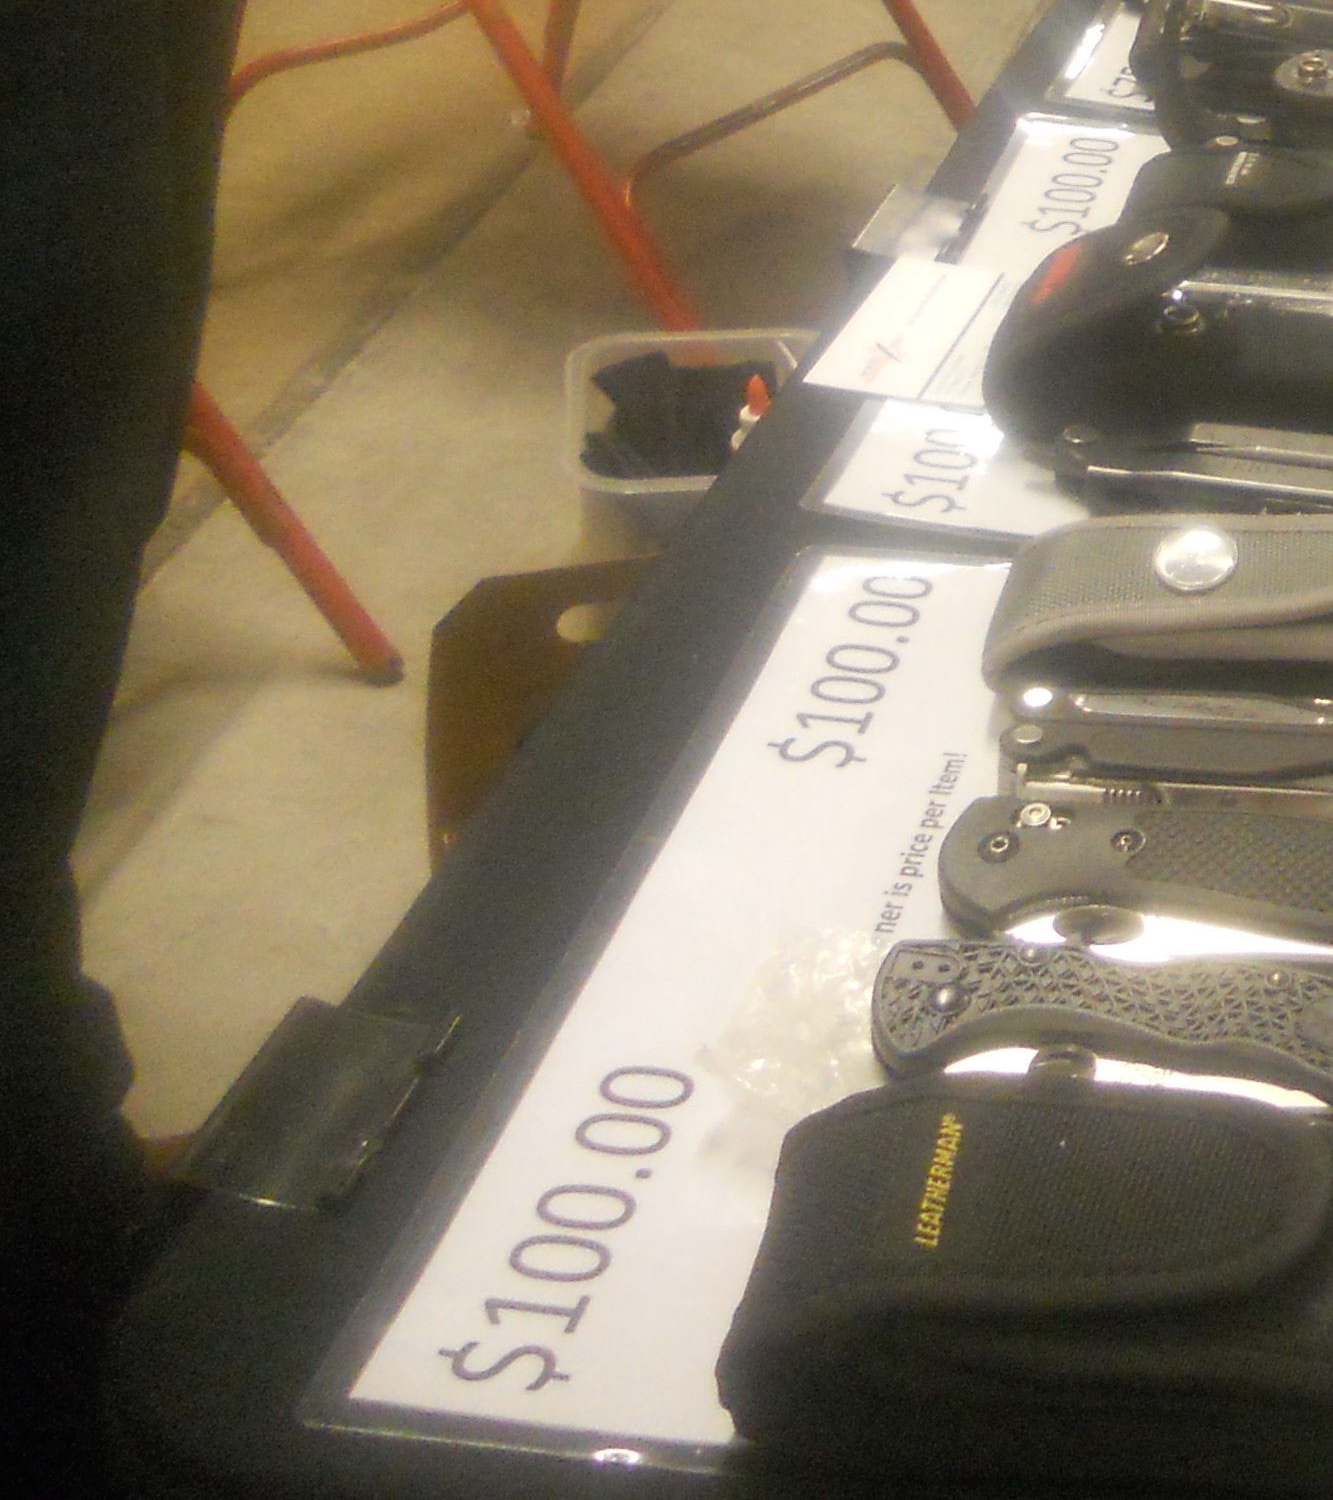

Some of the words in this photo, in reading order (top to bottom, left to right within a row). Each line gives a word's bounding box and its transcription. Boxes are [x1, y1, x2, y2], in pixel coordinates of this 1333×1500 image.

[1020, 137, 1119, 236] $100.00
[767, 574, 933, 768] $100.00
[884, 882, 912, 897] is
[900, 833, 933, 878] price
[920, 800, 946, 829] per
[438, 1065, 695, 1391] $100.00
